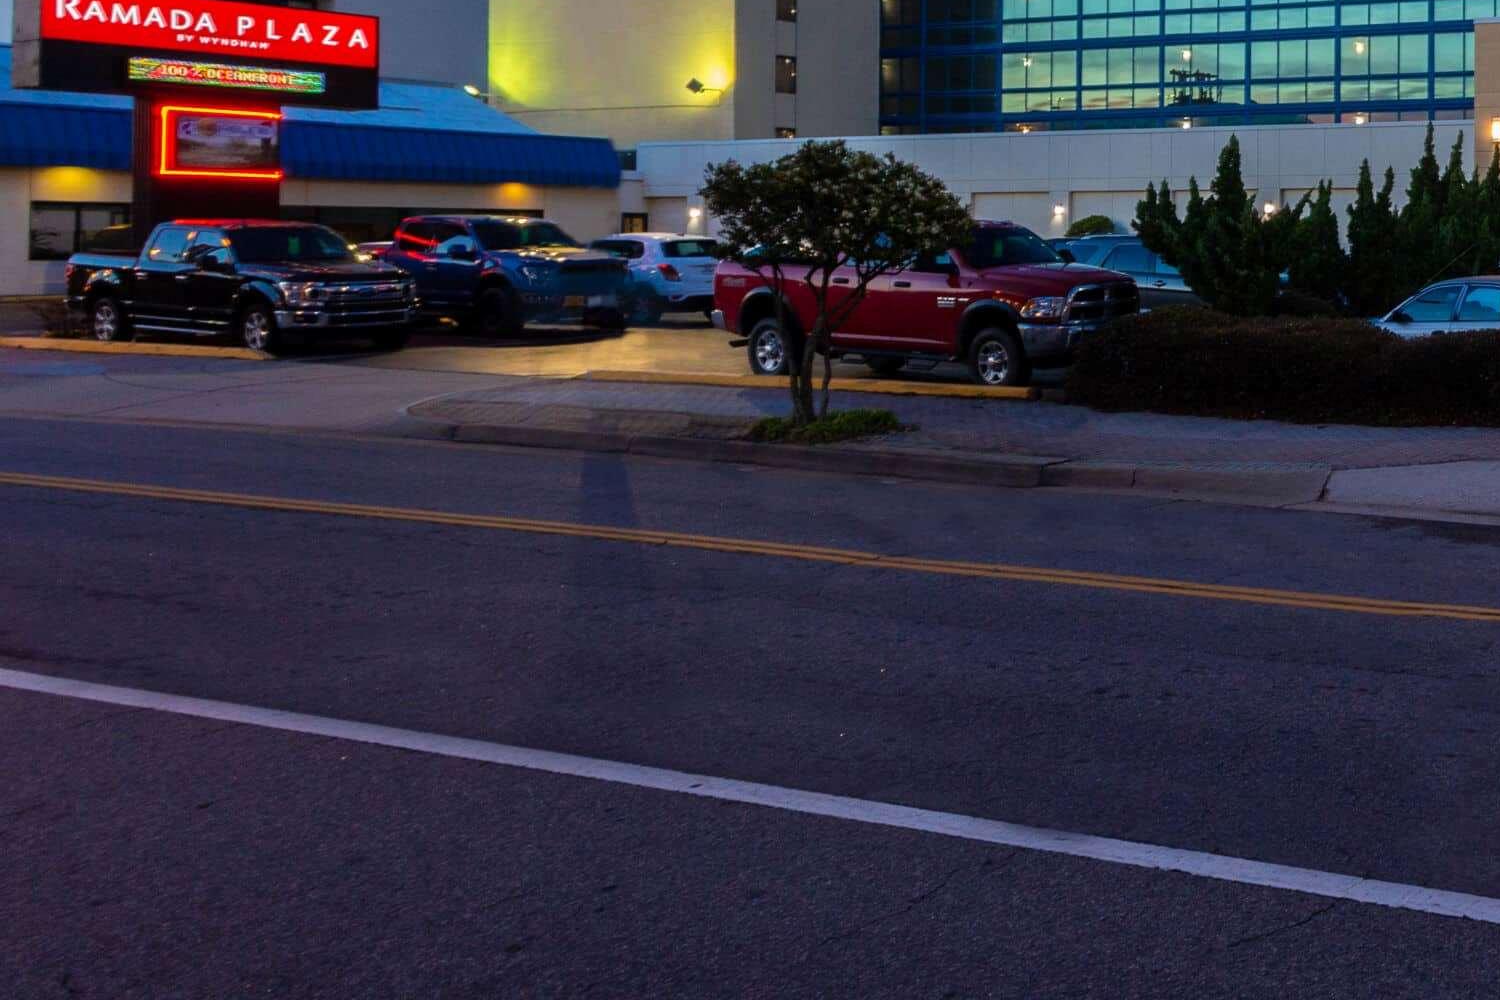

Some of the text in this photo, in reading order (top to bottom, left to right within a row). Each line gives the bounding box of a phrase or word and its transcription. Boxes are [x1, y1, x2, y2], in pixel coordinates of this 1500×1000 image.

[237, 16, 369, 49] PLAZA
[176, 34, 271, 49] BY WYNDHAM
[207, 68, 296, 84] OCEANFRONT
